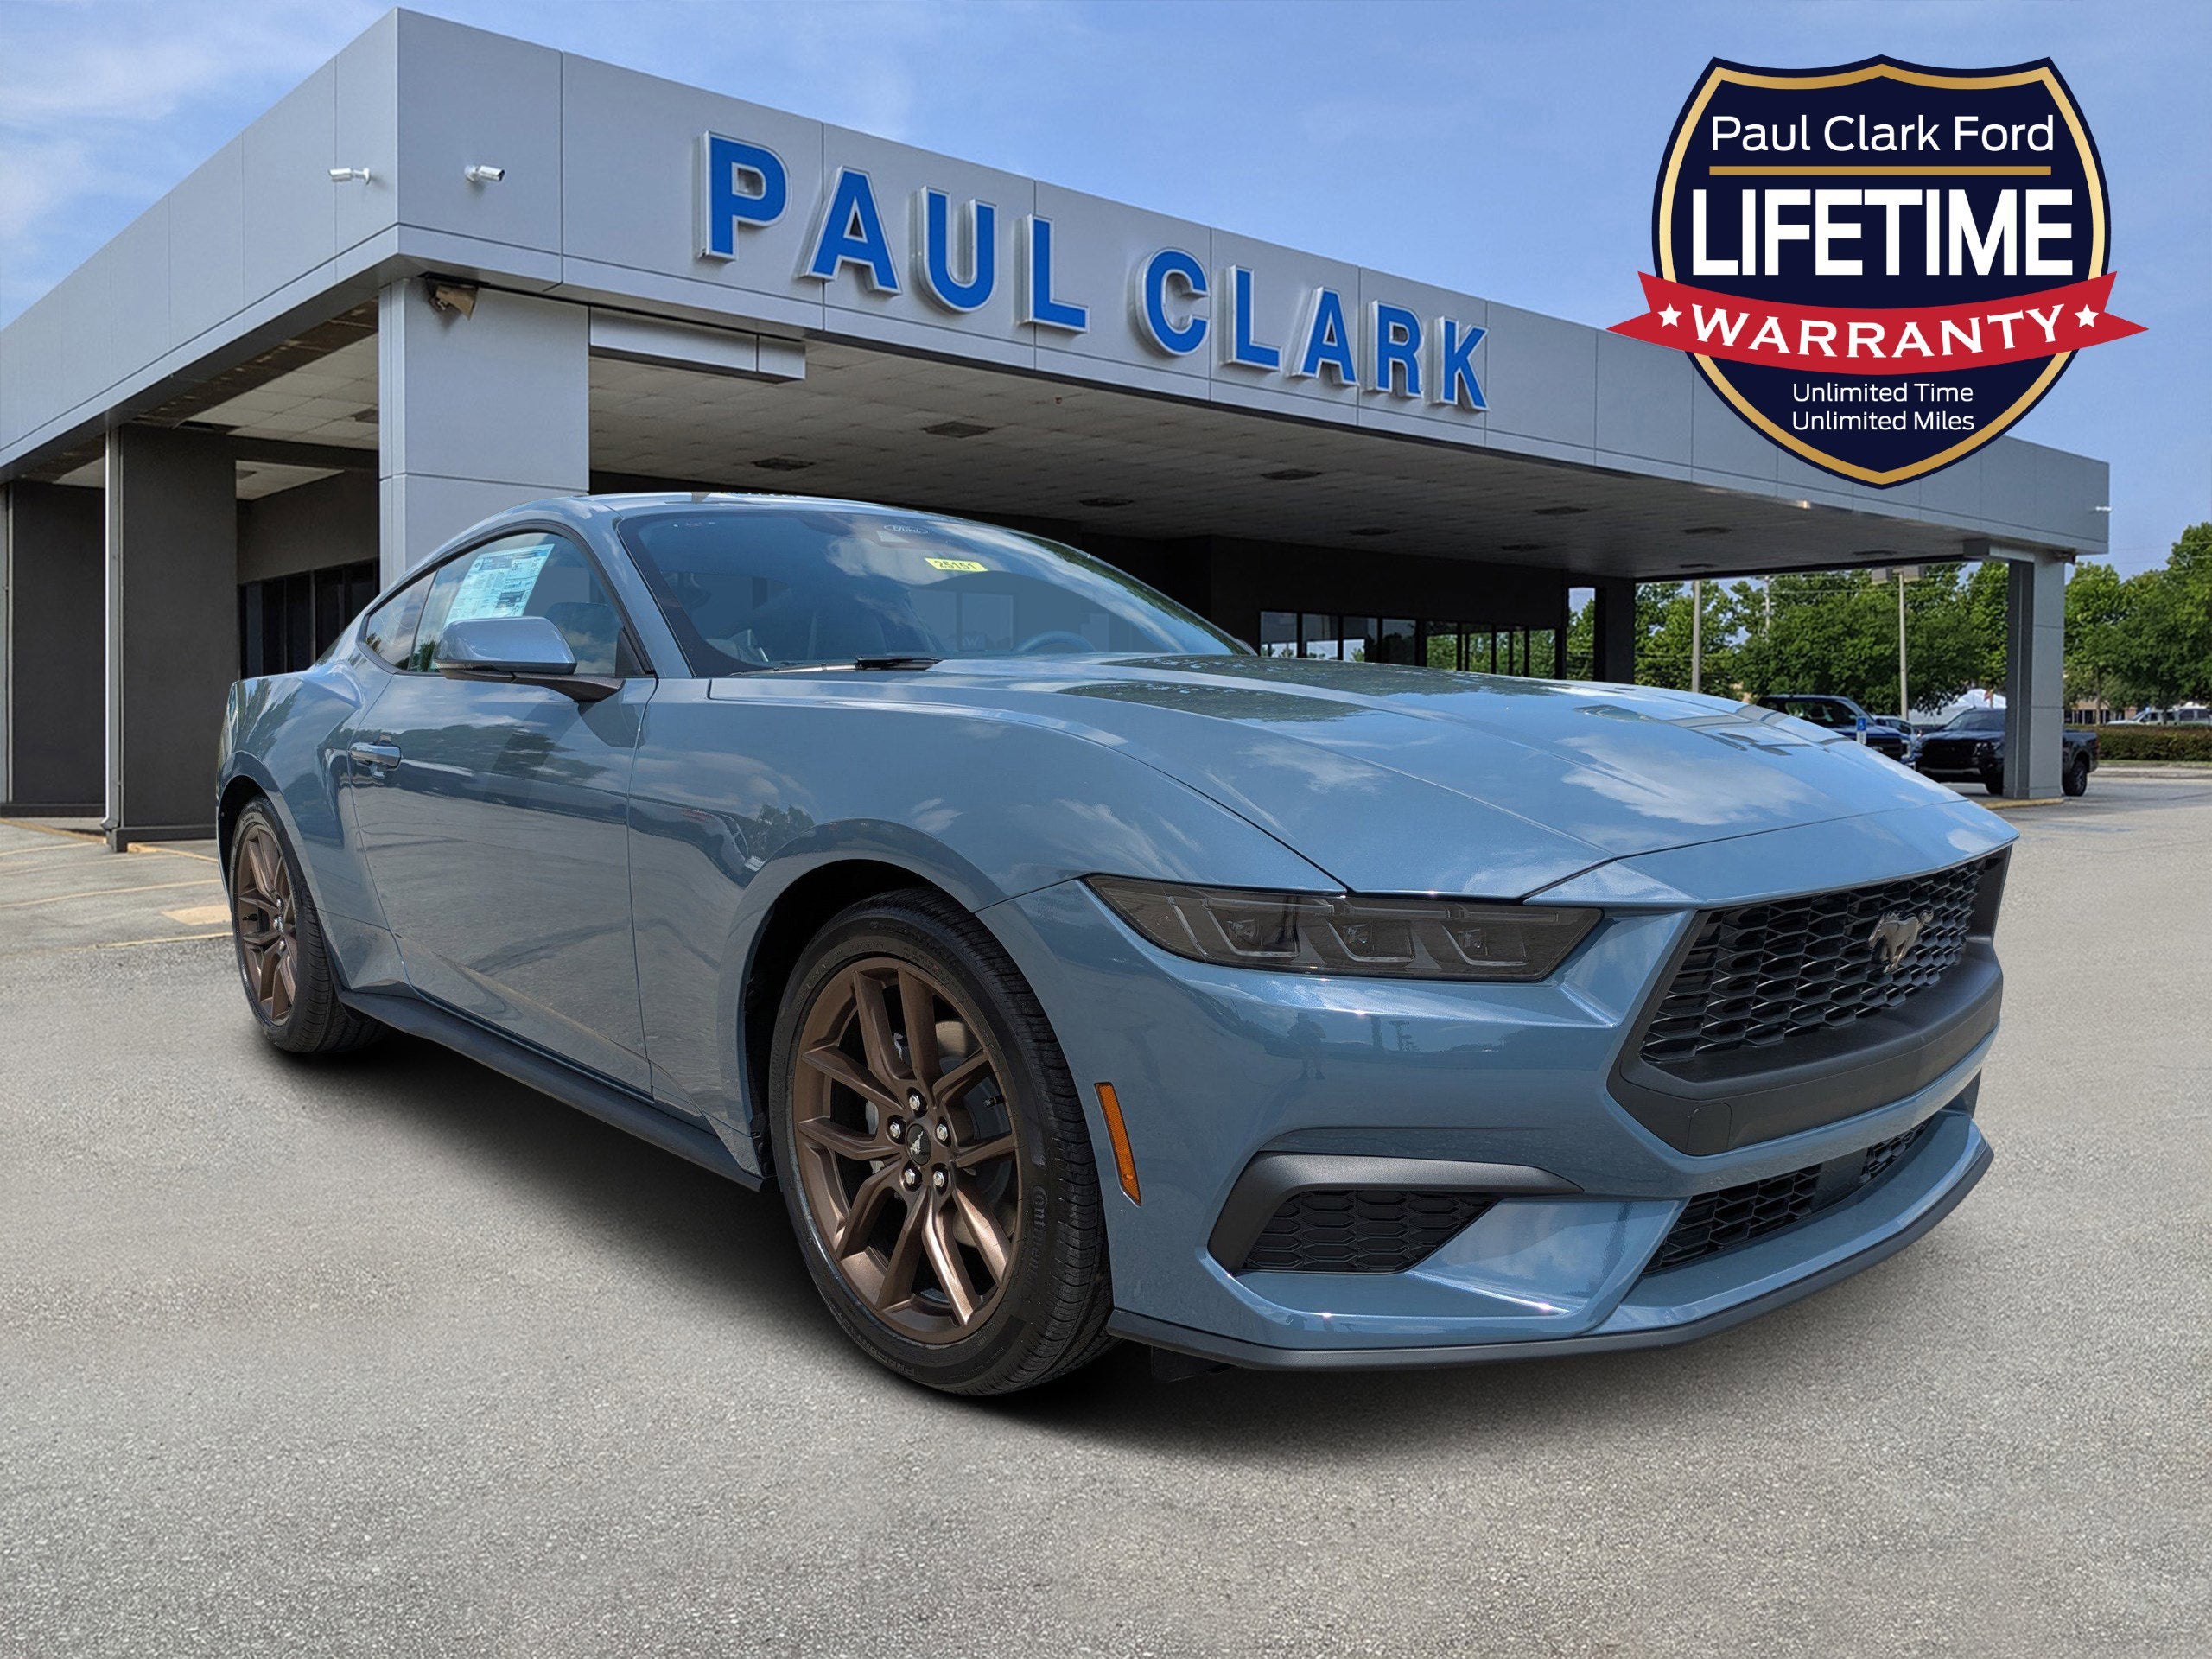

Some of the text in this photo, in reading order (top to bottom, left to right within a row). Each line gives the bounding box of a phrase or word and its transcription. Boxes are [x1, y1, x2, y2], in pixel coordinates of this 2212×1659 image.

[702, 133, 1488, 410] PAUL CLARK
[933, 560, 977, 570] 25151
